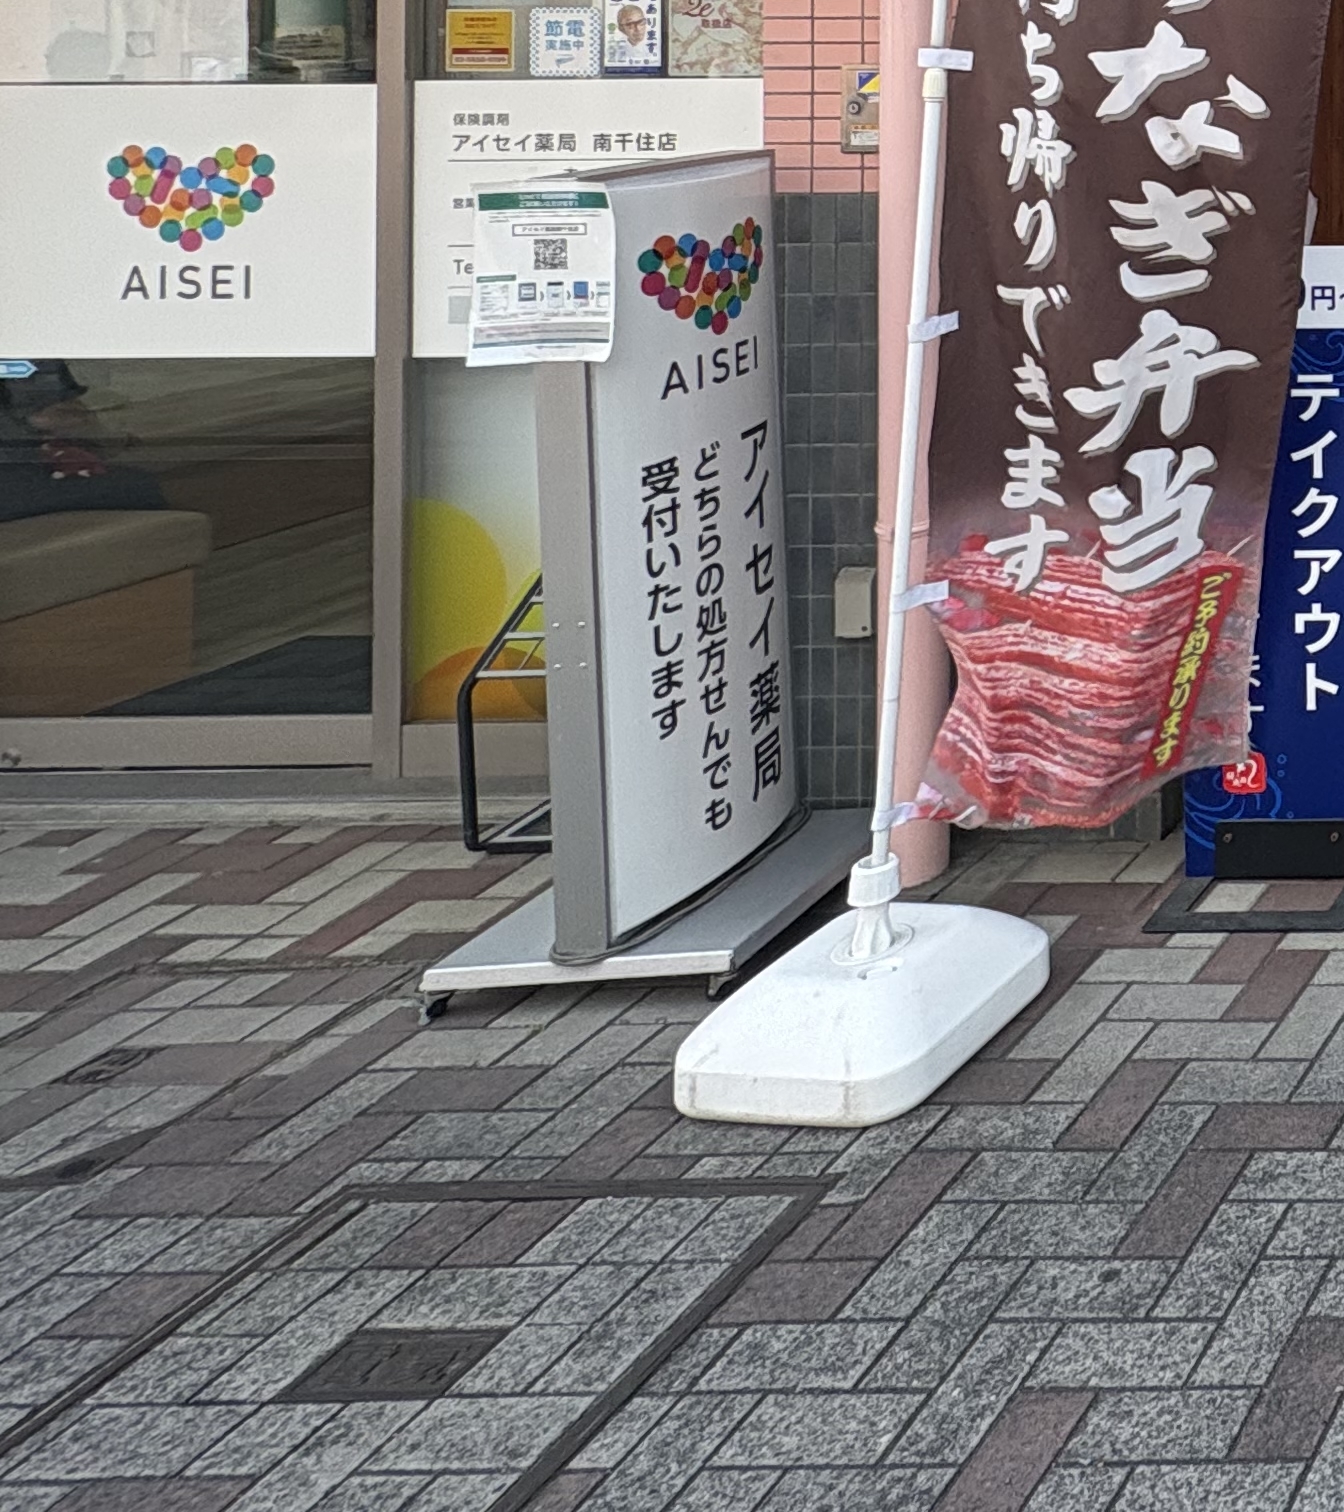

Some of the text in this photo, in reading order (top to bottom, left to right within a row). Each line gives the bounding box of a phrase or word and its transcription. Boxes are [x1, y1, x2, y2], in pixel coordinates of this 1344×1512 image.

[544, 19, 586, 37] 節電
[545, 39, 585, 51] 実施中
[452, 133, 678, 153] アイセイ薬局 南千住店
[121, 265, 252, 300] AISEI
[661, 335, 759, 400] AISEI
[640, 455, 684, 740] 受付いたします
[1290, 374, 1342, 712] テイクアウト
[693, 441, 734, 831] どちらの処方せんでも
[741, 419, 783, 803] アイセイ薬局
[1153, 571, 1232, 767] ご予約承ります
